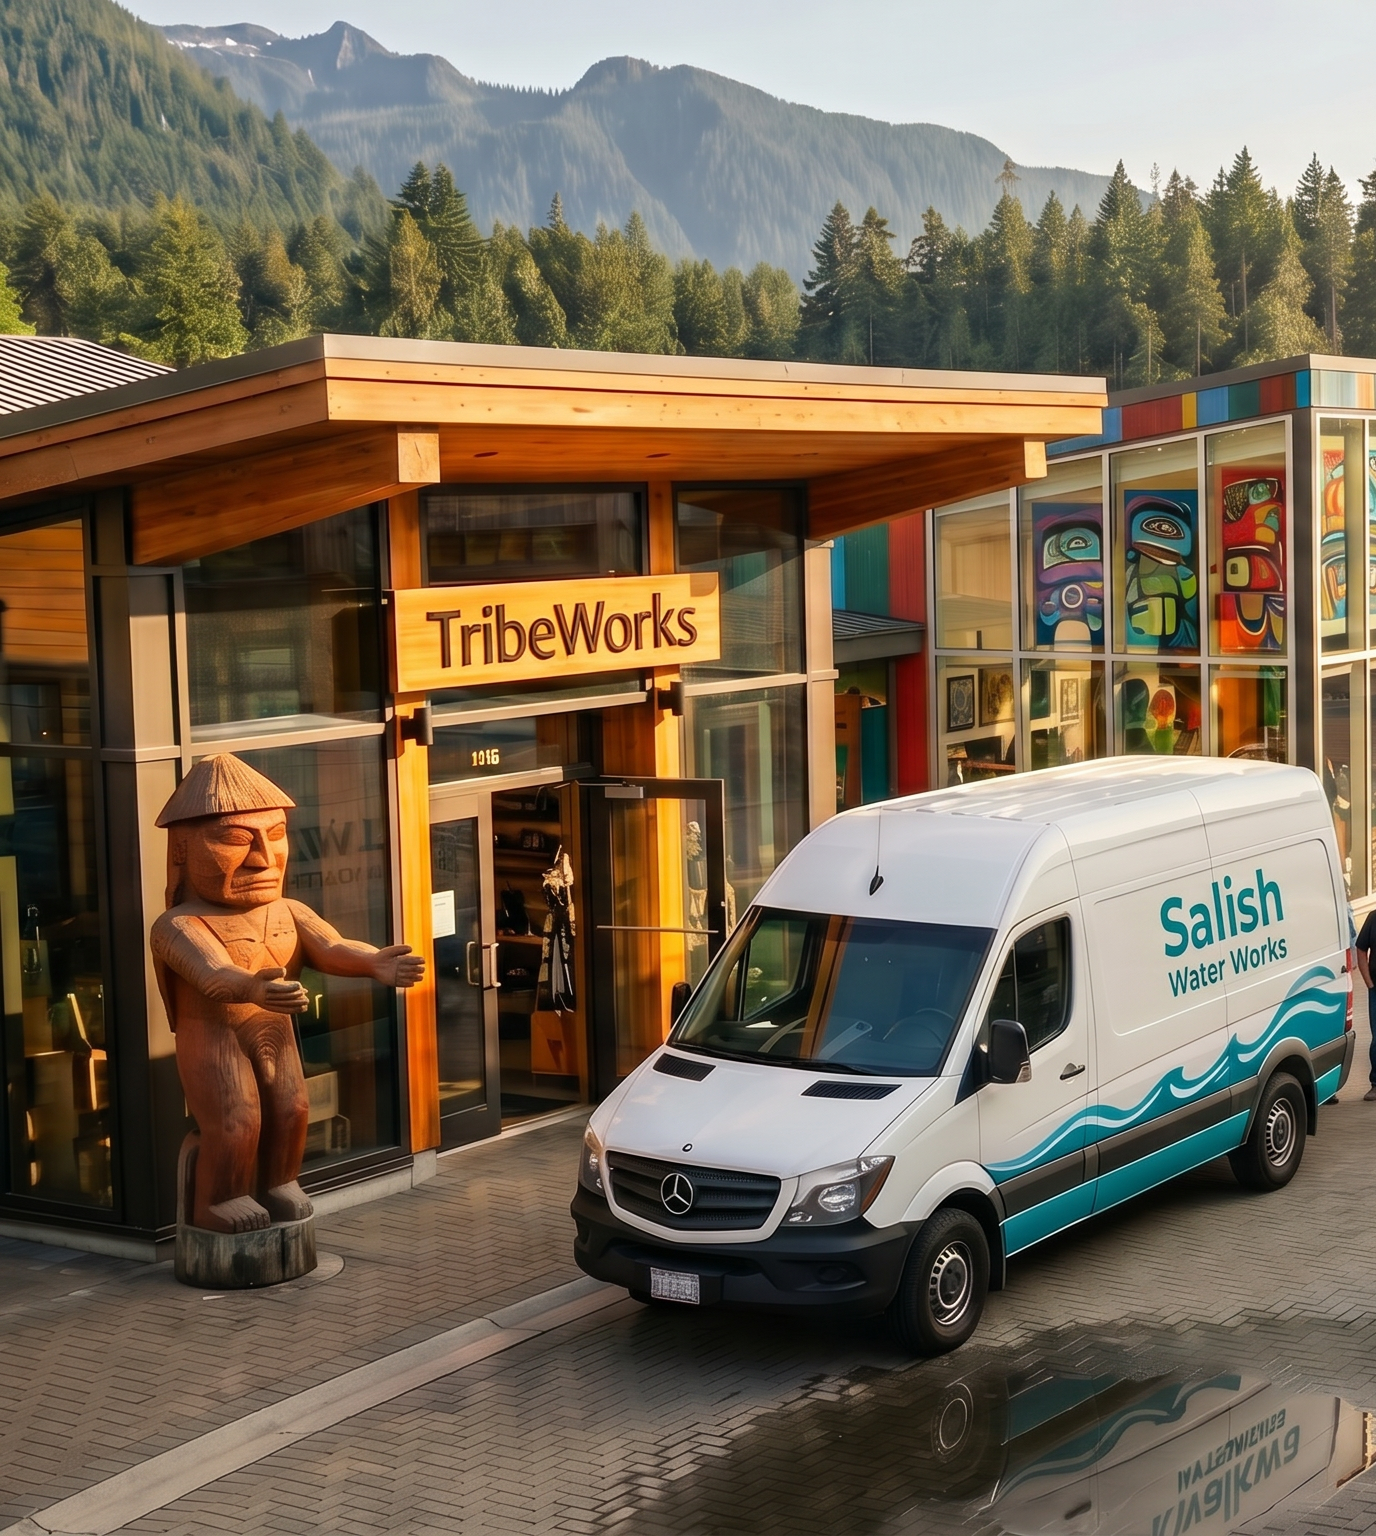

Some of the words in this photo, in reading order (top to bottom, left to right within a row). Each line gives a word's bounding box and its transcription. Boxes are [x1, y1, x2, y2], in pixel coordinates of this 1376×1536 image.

[426, 593, 698, 669] TribeWorks
[1160, 869, 1284, 957] Salish
[1168, 959, 1225, 998] Water
[1230, 936, 1287, 975] Works
